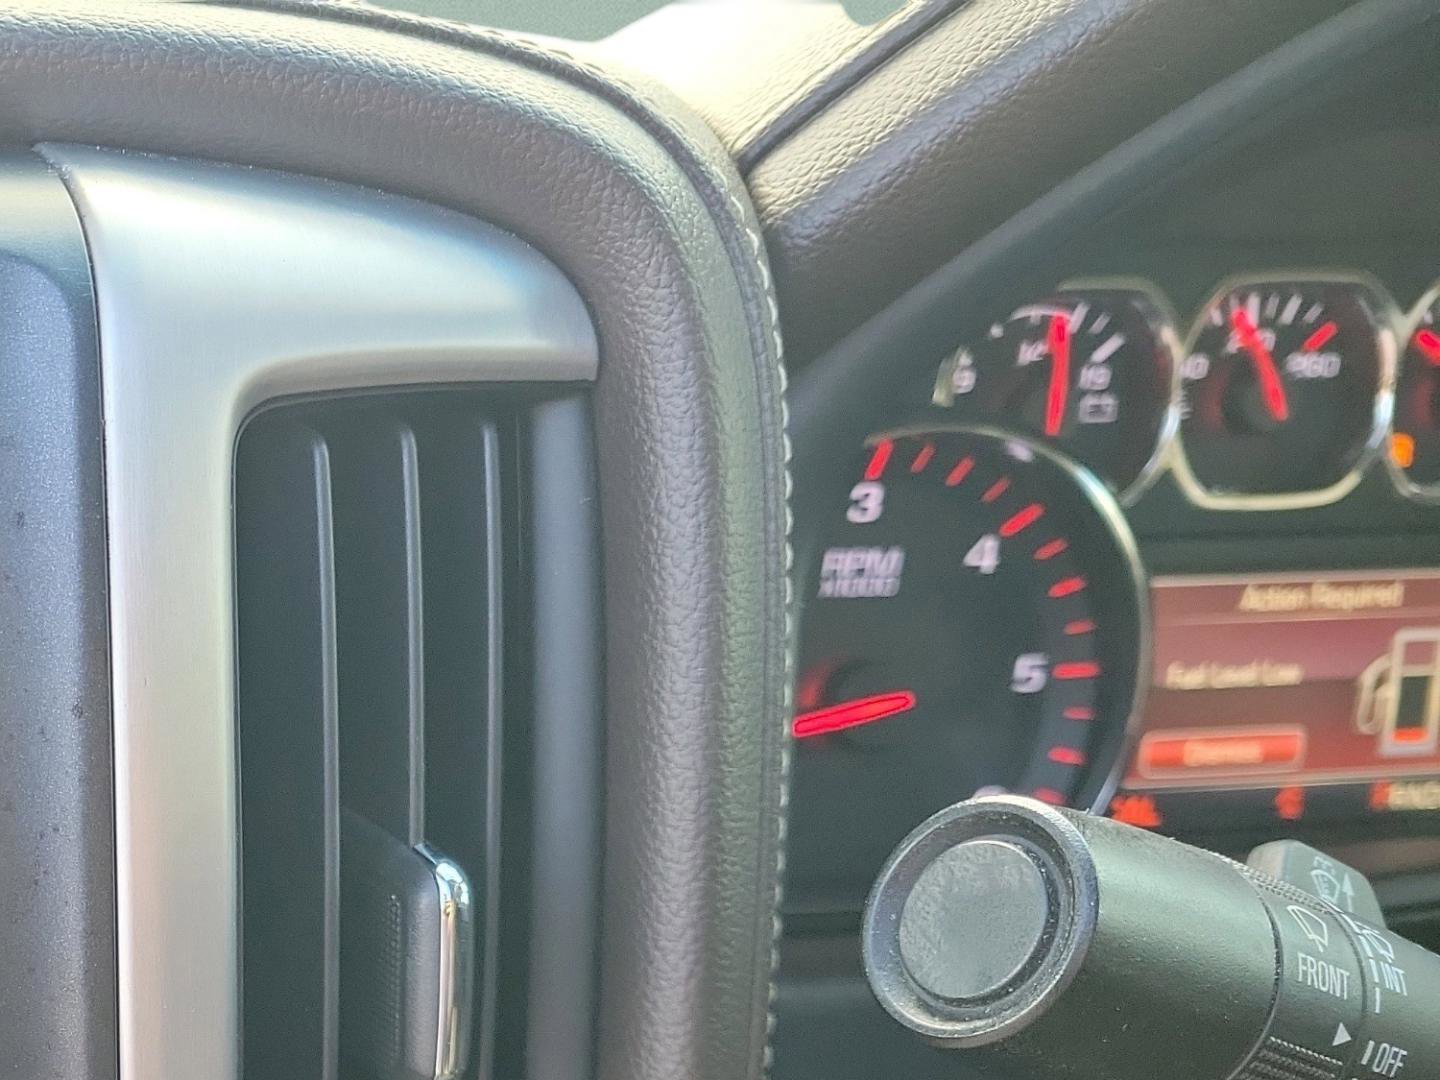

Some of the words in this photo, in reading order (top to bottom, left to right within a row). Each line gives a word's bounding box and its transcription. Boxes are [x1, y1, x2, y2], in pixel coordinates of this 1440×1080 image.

[846, 480, 884, 523] 3
[963, 532, 1001, 575] 4
[1013, 652, 1050, 694] 5
[1297, 952, 1350, 1001] FRONT
[1380, 961, 1408, 996] INT
[1372, 1042, 1408, 1079] OFF
